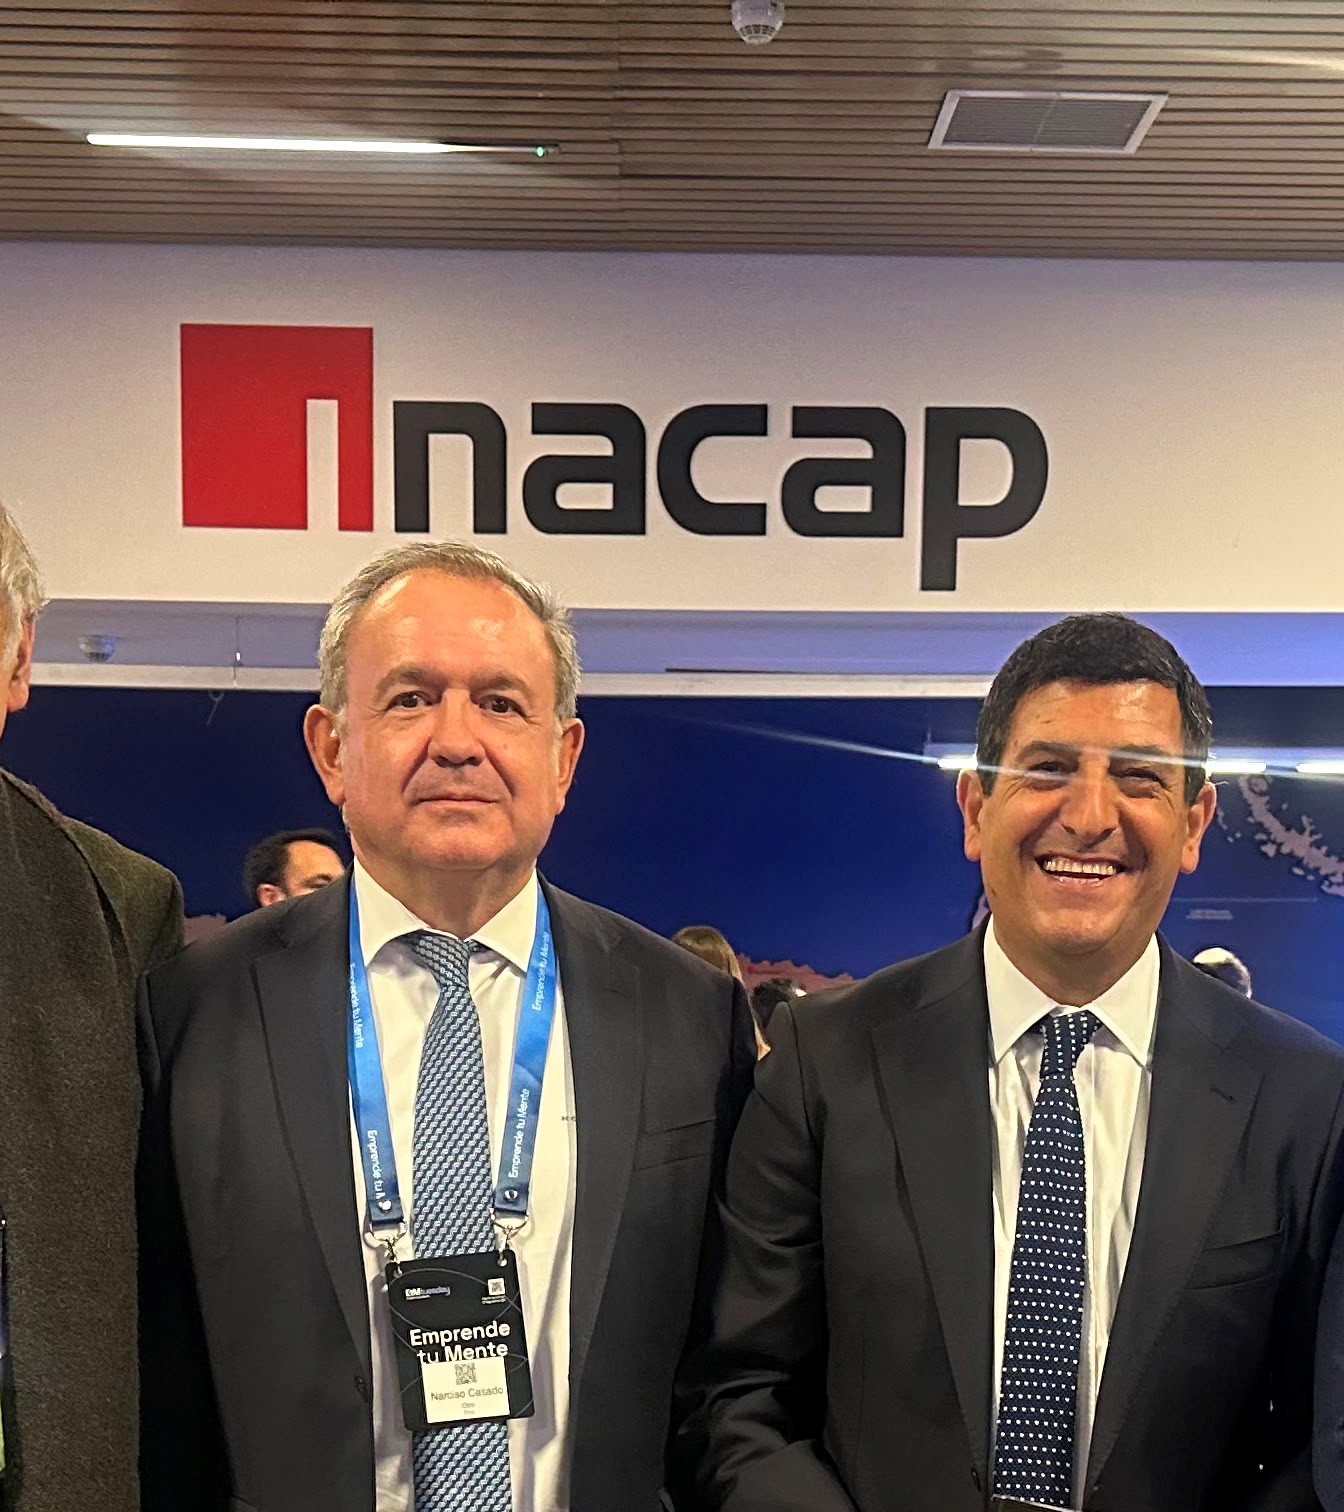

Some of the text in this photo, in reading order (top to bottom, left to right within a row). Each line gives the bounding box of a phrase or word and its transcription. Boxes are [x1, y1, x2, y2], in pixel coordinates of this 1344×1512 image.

[409, 1320, 511, 1347] Emprende
[416, 1341, 509, 1364] tu Mente
